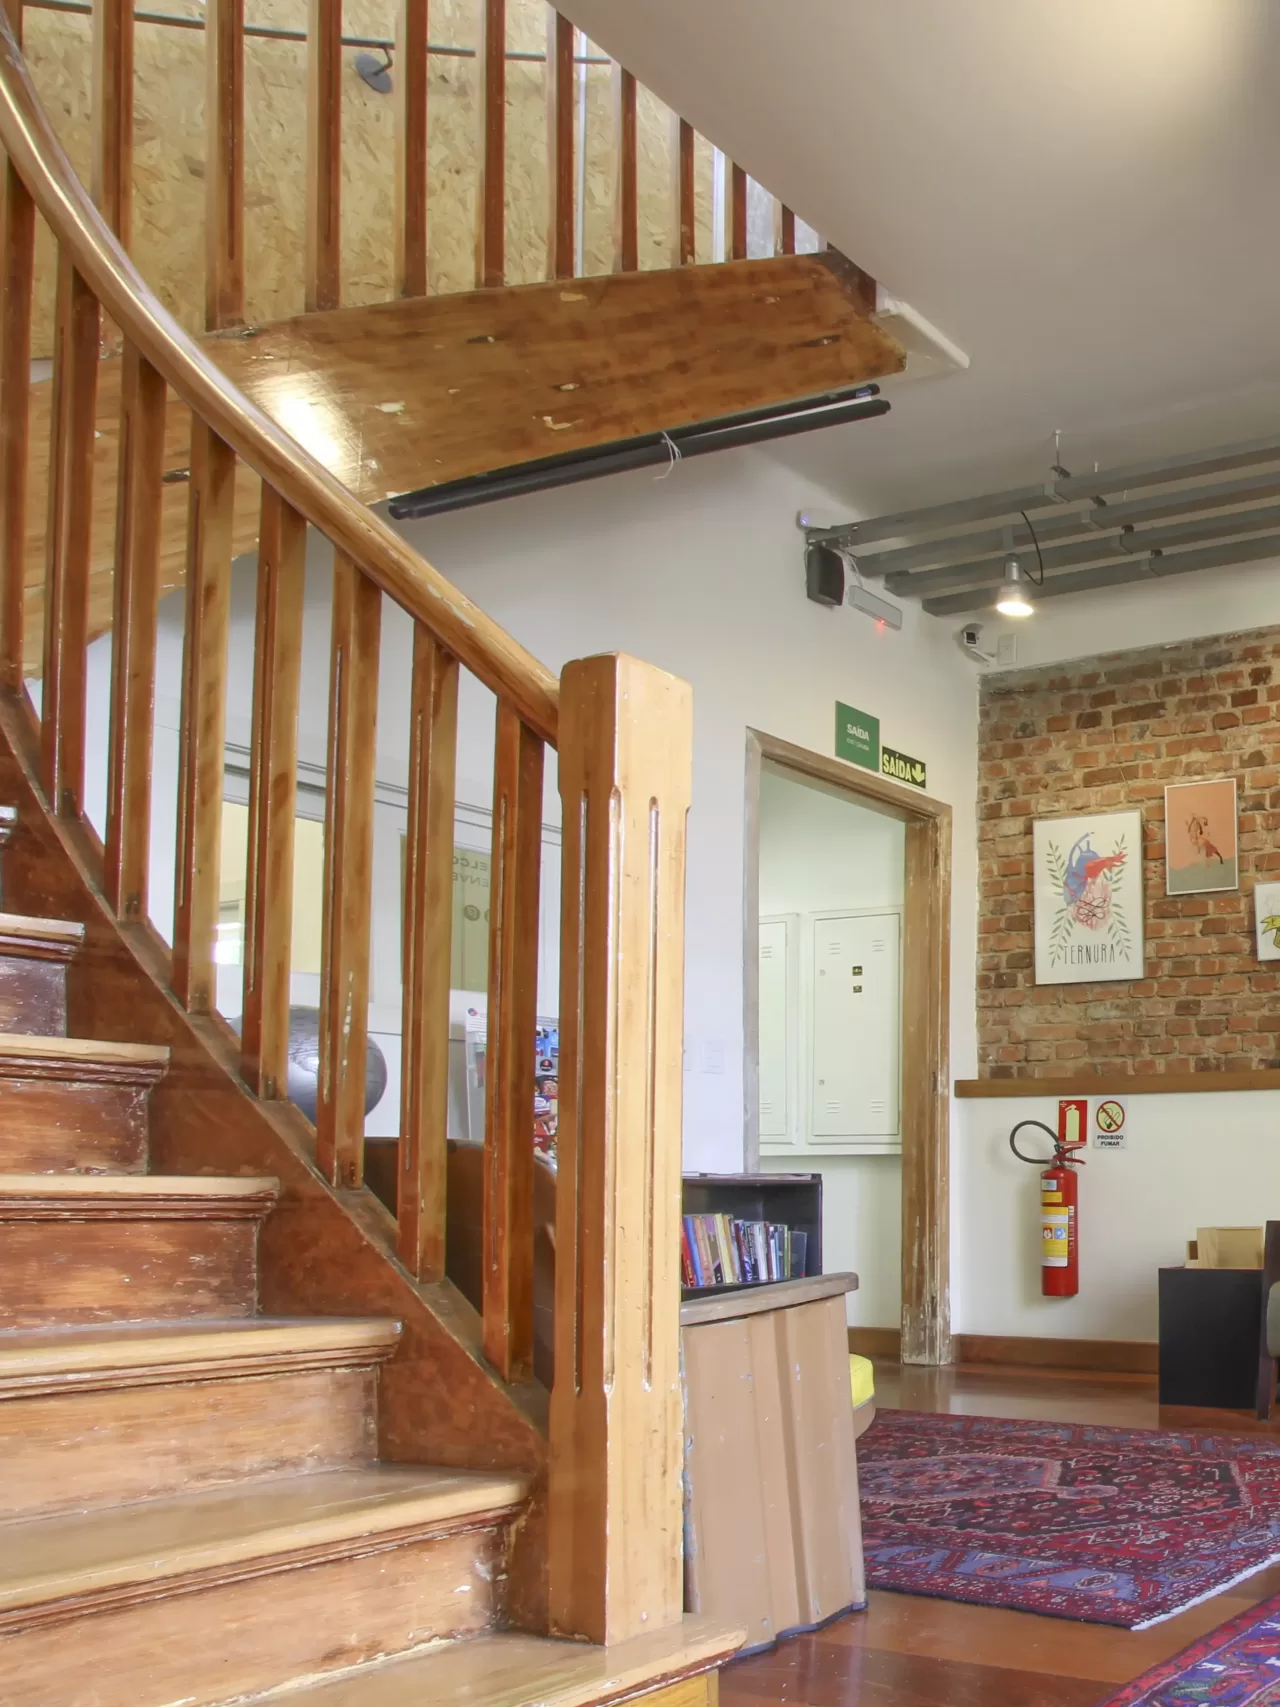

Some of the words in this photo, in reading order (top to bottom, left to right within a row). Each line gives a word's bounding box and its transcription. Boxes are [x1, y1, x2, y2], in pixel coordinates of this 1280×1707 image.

[847, 724, 869, 741] SAÍDA
[883, 753, 912, 782] SAÍDA
[1063, 943, 1116, 965] TERNURA
